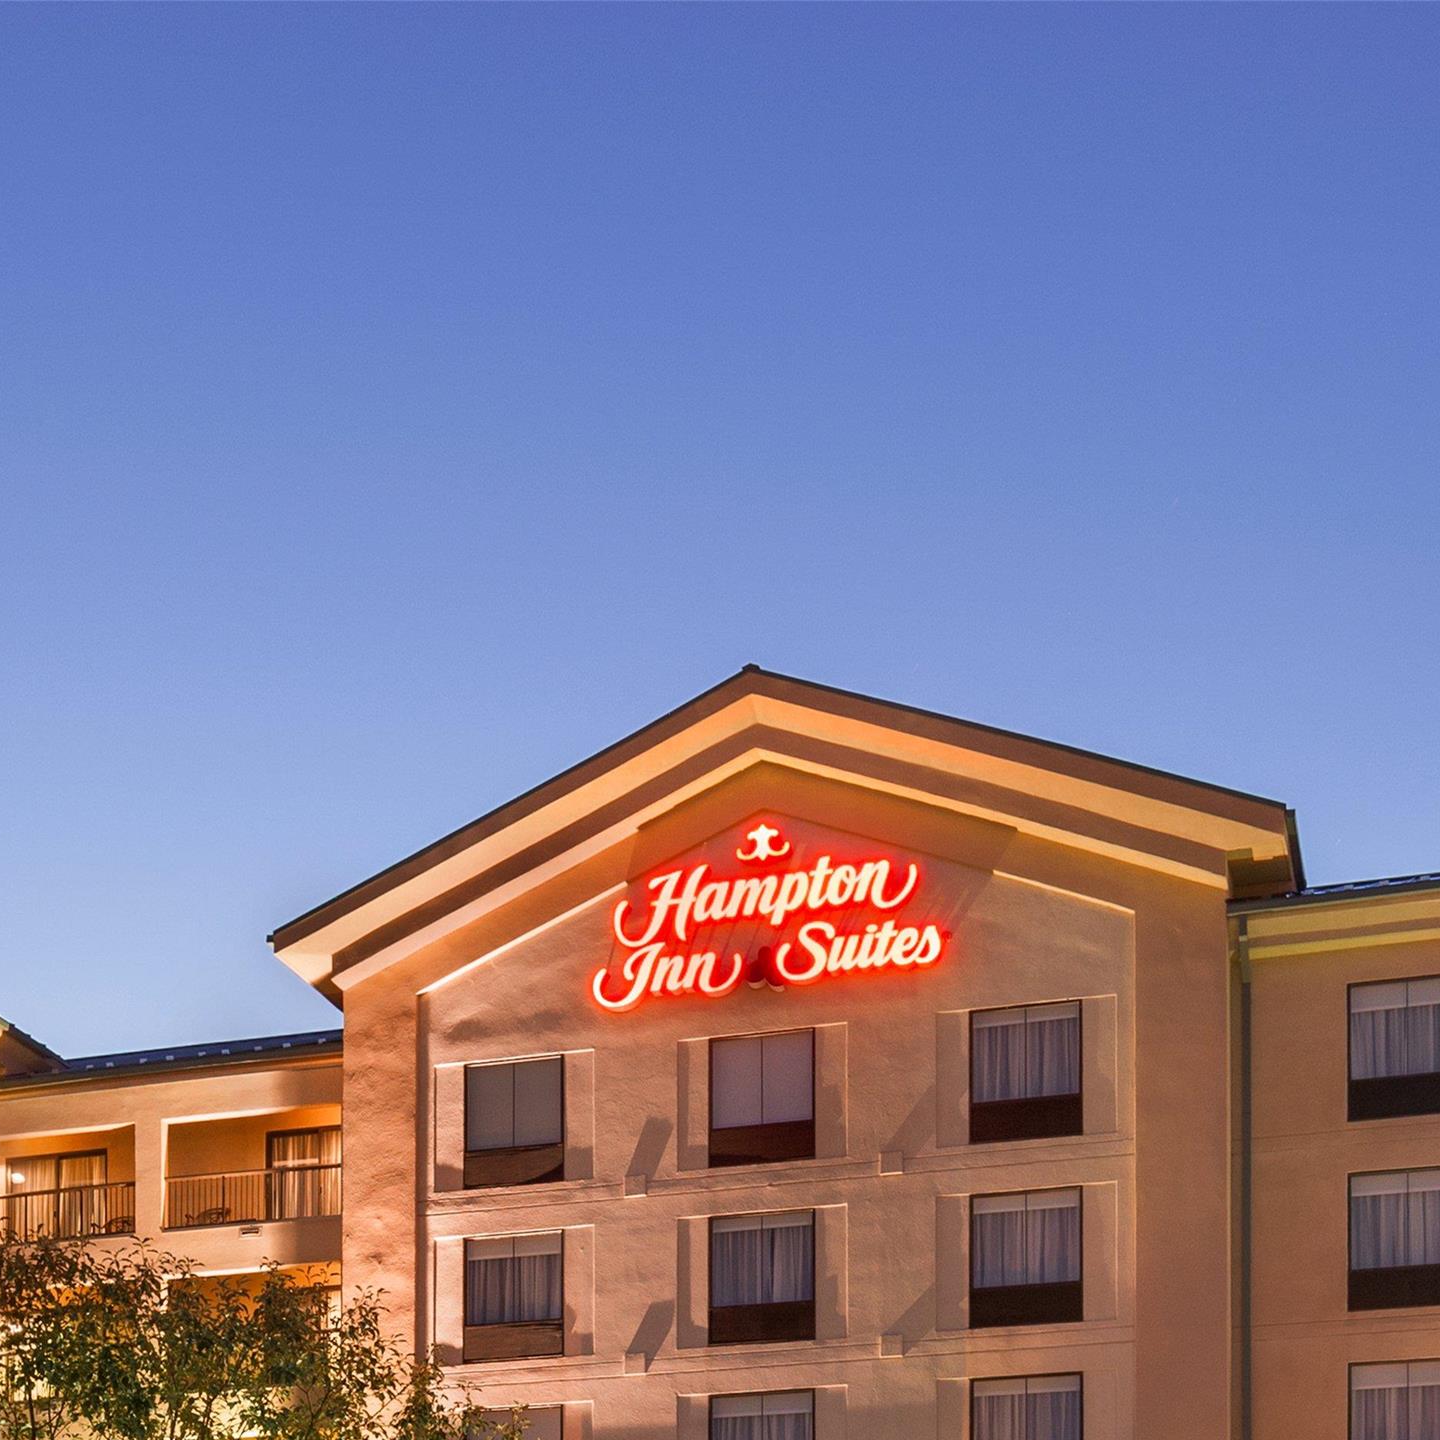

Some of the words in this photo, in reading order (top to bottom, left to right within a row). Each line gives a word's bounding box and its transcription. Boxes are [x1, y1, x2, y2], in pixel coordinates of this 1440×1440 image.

[614, 856, 918, 947] Hampton
[592, 942, 742, 1008] Inn
[776, 920, 942, 981] Suites
